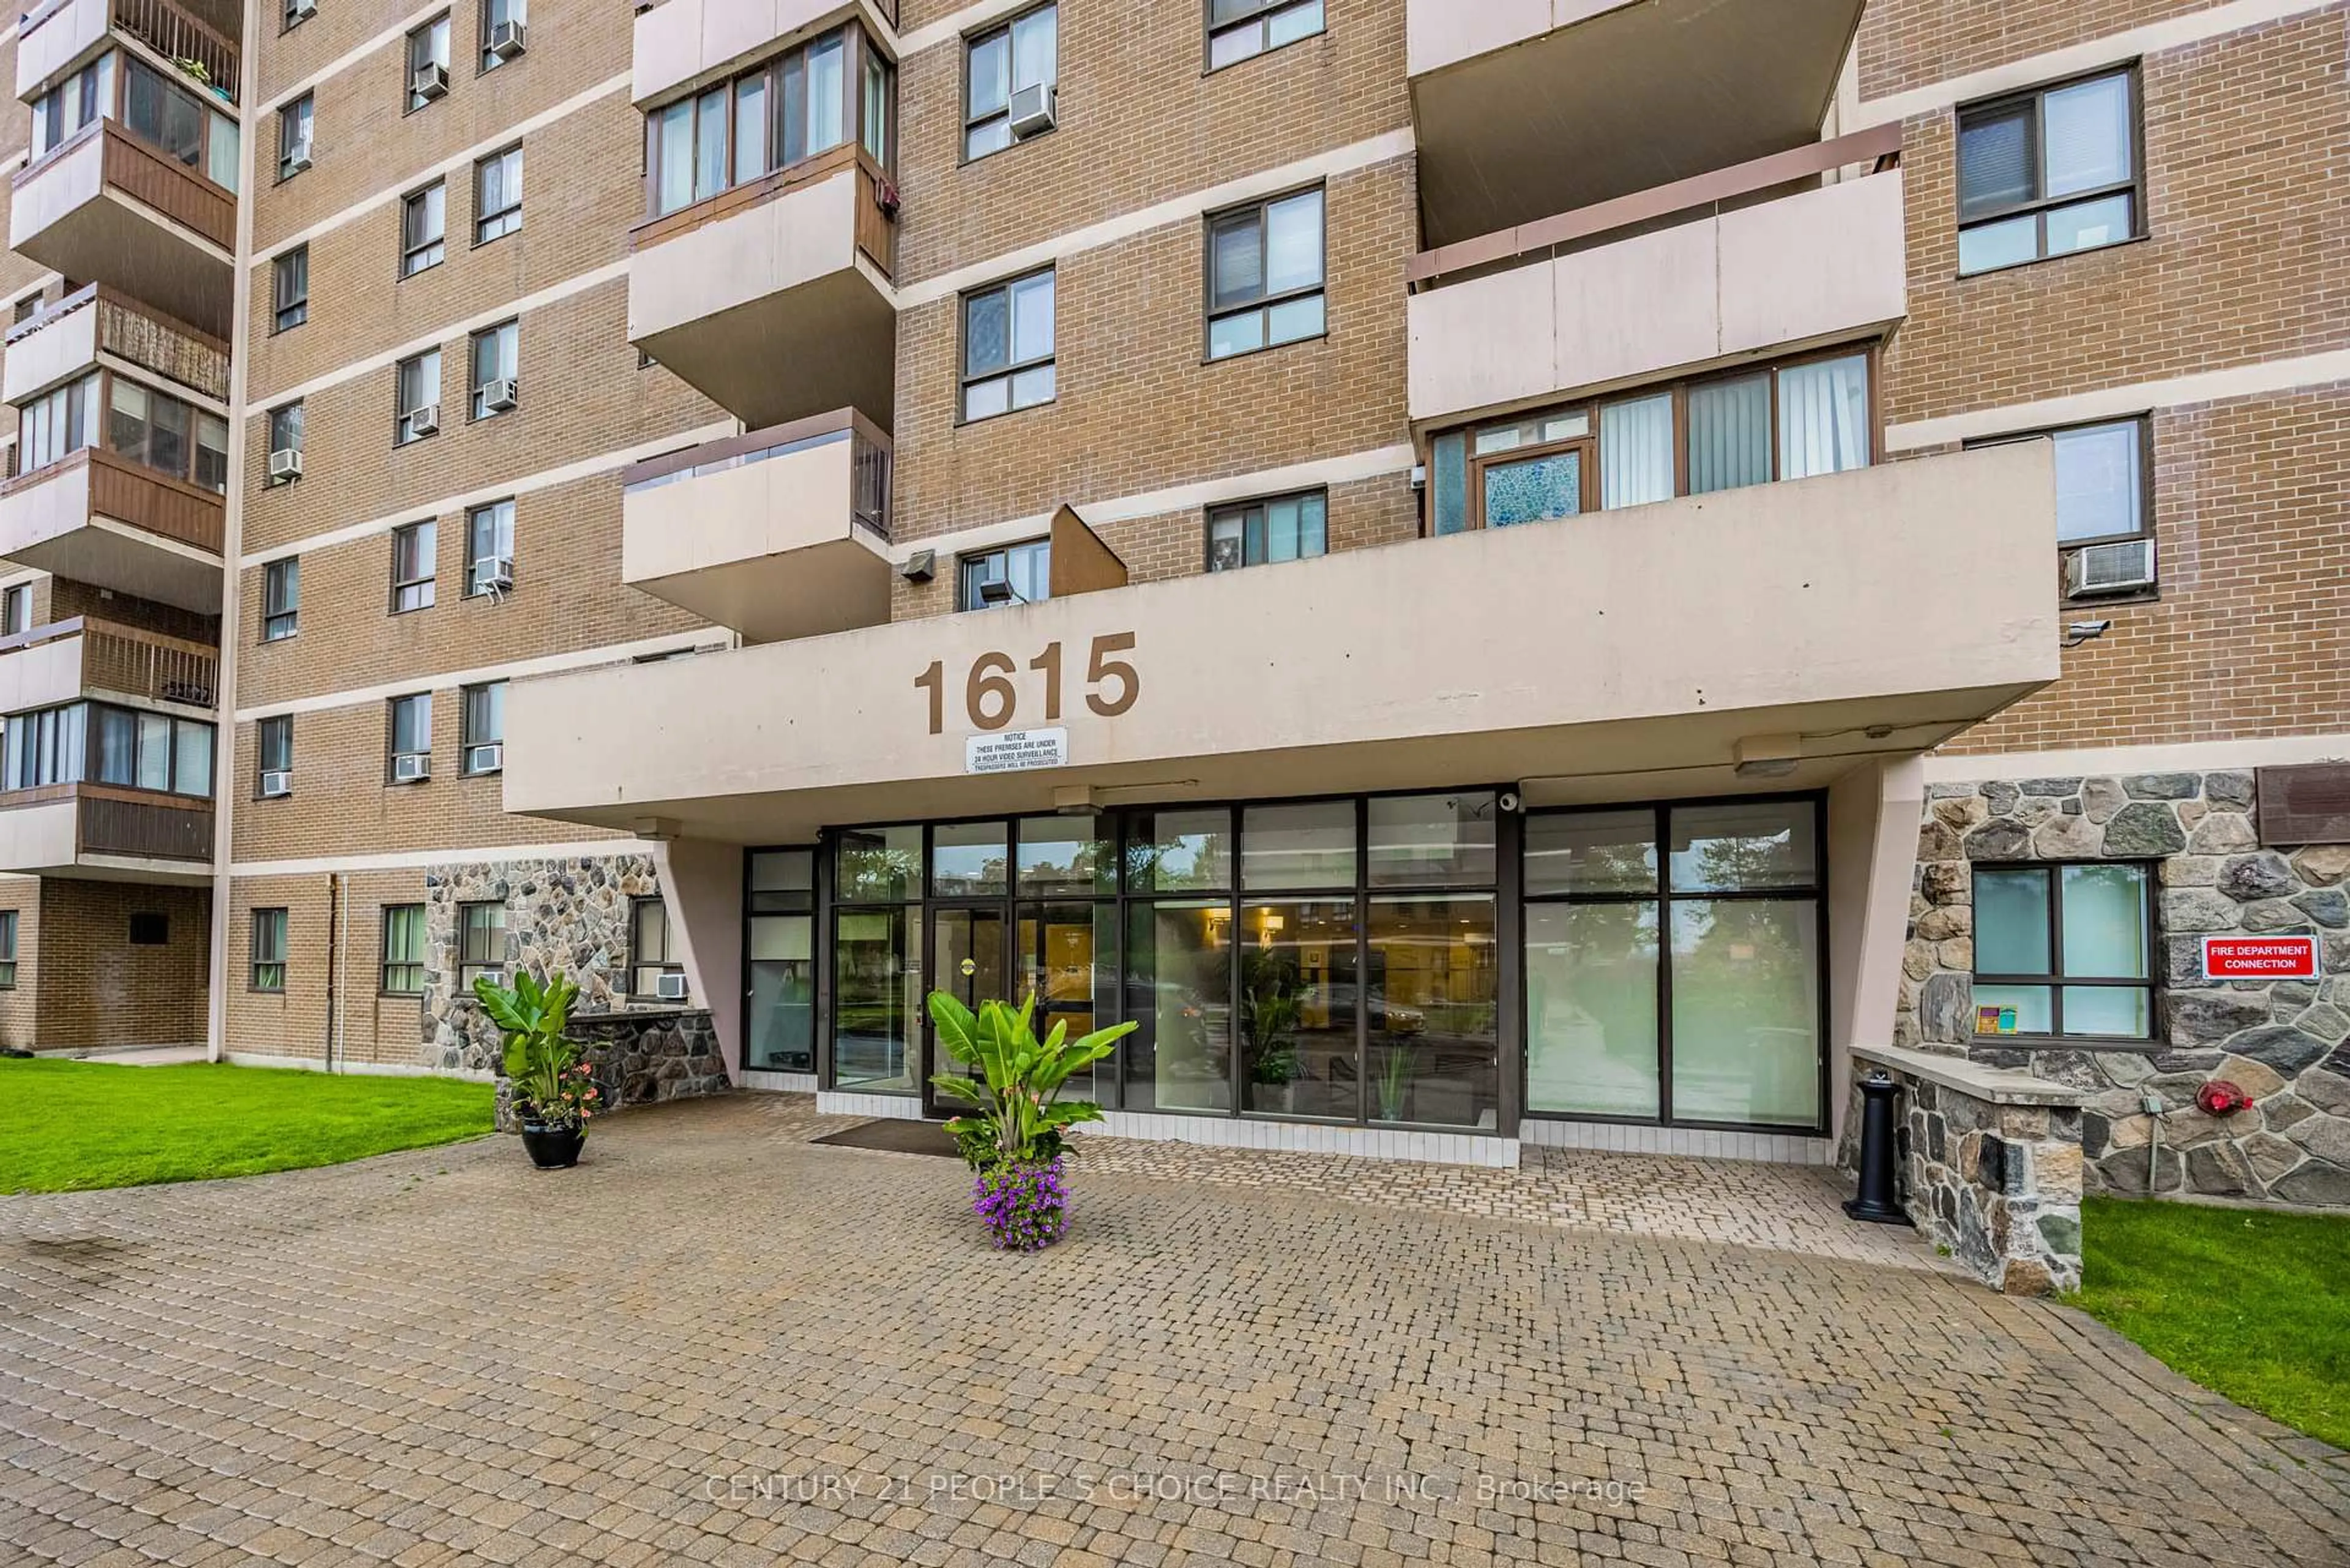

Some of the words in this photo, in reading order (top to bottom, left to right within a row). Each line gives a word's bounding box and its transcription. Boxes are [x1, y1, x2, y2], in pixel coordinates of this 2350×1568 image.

[914, 632, 1140, 734] 1615
[1004, 733, 1026, 742] NOTICE
[994, 742, 1022, 751] PREMISES
[1037, 739, 1056, 747] UNDER
[982, 753, 998, 762] HOUR
[999, 751, 1015, 760] VIDEO
[1016, 748, 1058, 759] SURVEILLANCE
[2211, 947, 2234, 956] FIRE
[2237, 946, 2308, 955] DEPARTMENT
[2225, 959, 2296, 969] CONNECTION
